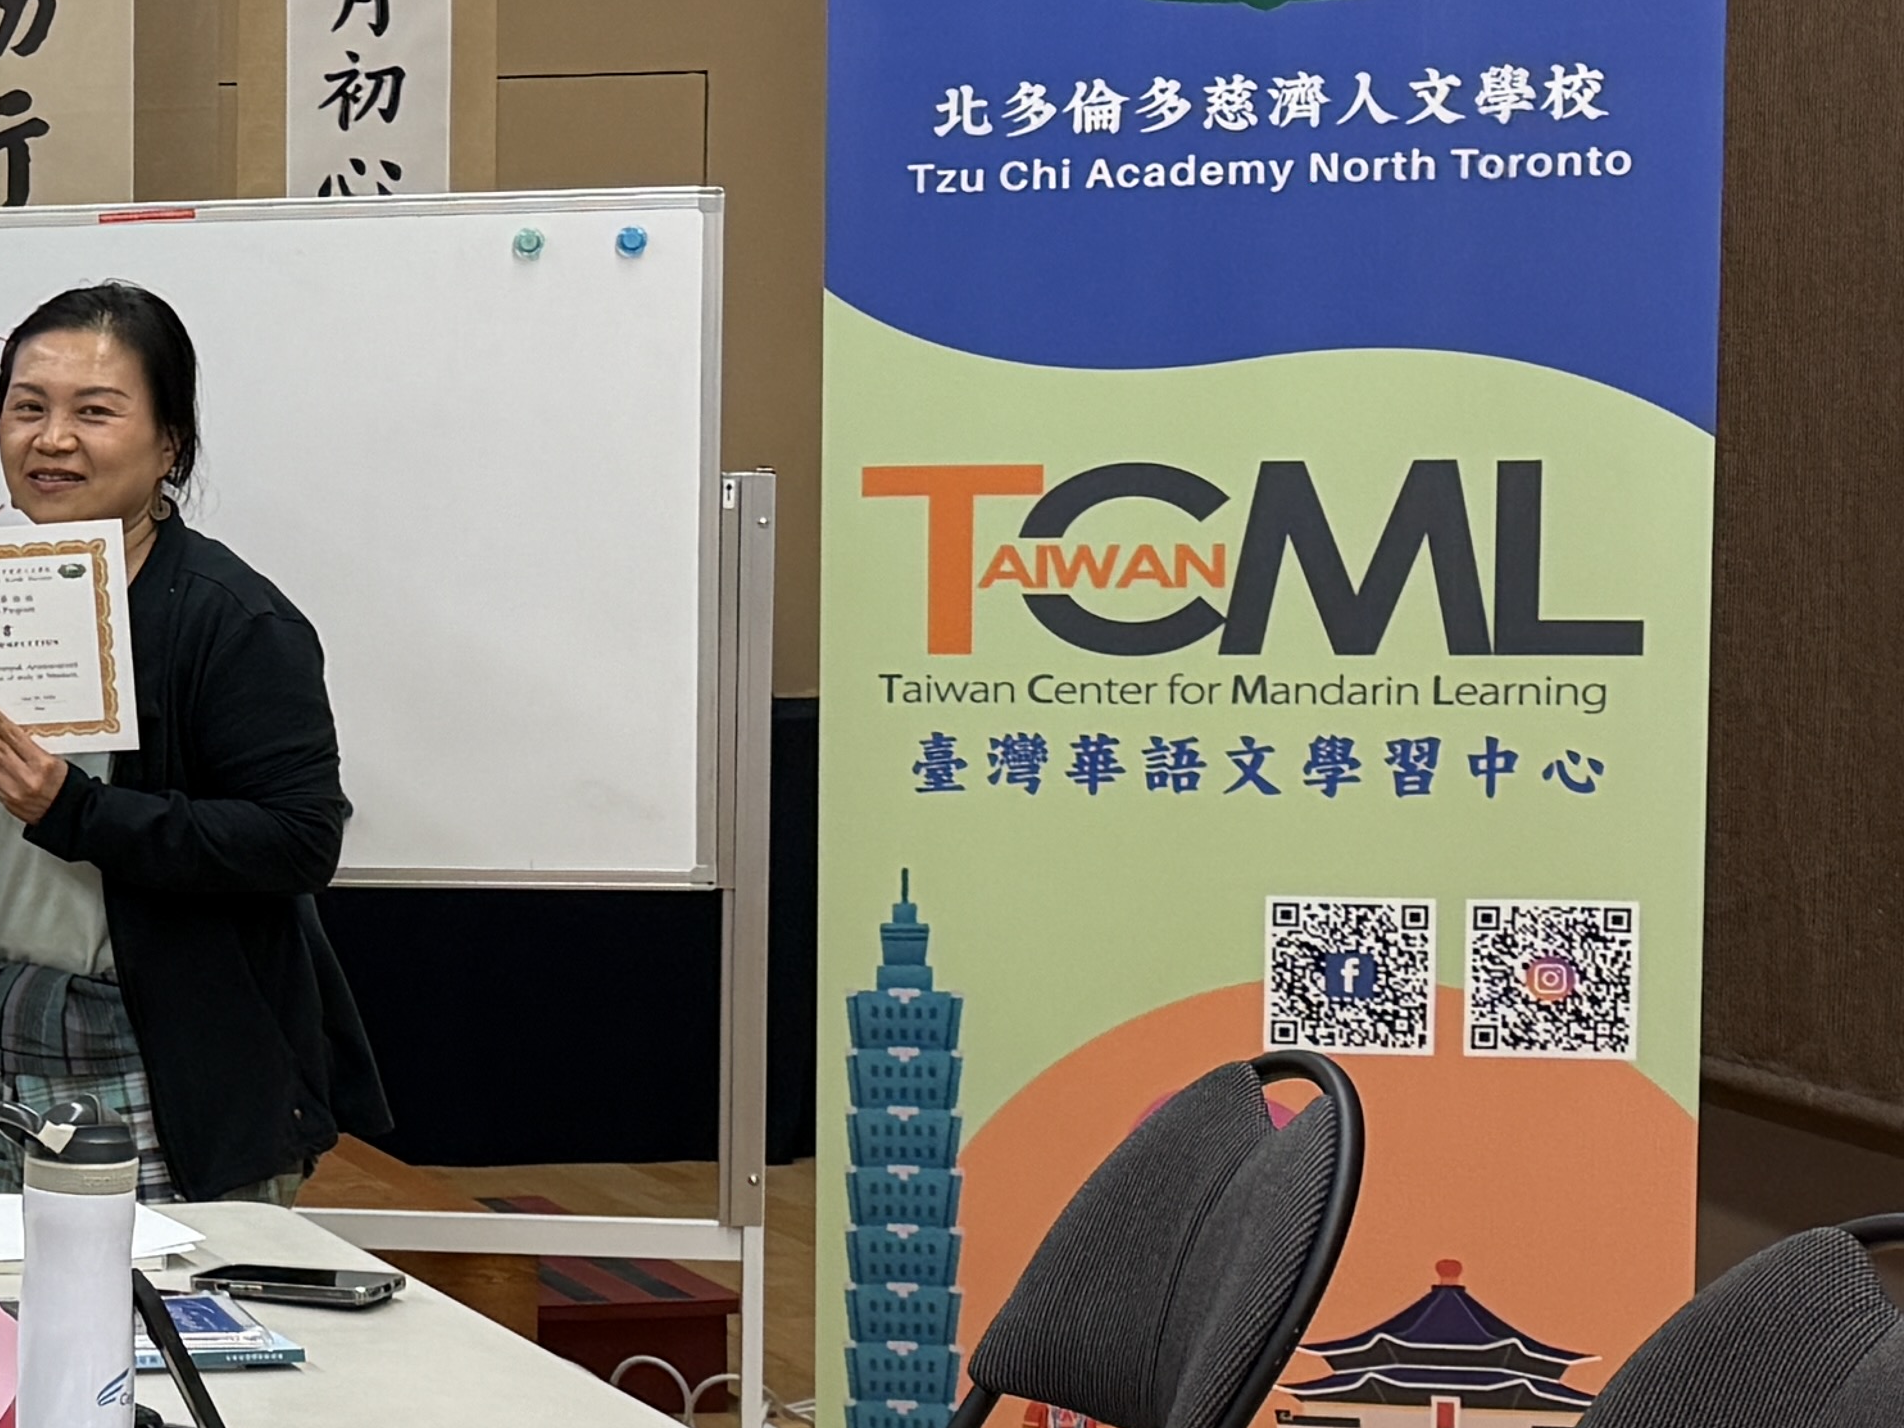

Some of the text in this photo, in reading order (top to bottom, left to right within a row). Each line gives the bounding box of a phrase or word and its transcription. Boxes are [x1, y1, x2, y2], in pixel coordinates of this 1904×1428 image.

[933, 62, 1610, 139] 北多倫多慈濟人文學校
[907, 145, 1633, 195] Tzu Chi Academy North Toronto
[861, 458, 1644, 658] TCML
[879, 673, 1609, 714] Taiwan Center for Mandarin Learning
[910, 730, 1606, 800] 臺灣華語文學習中心
